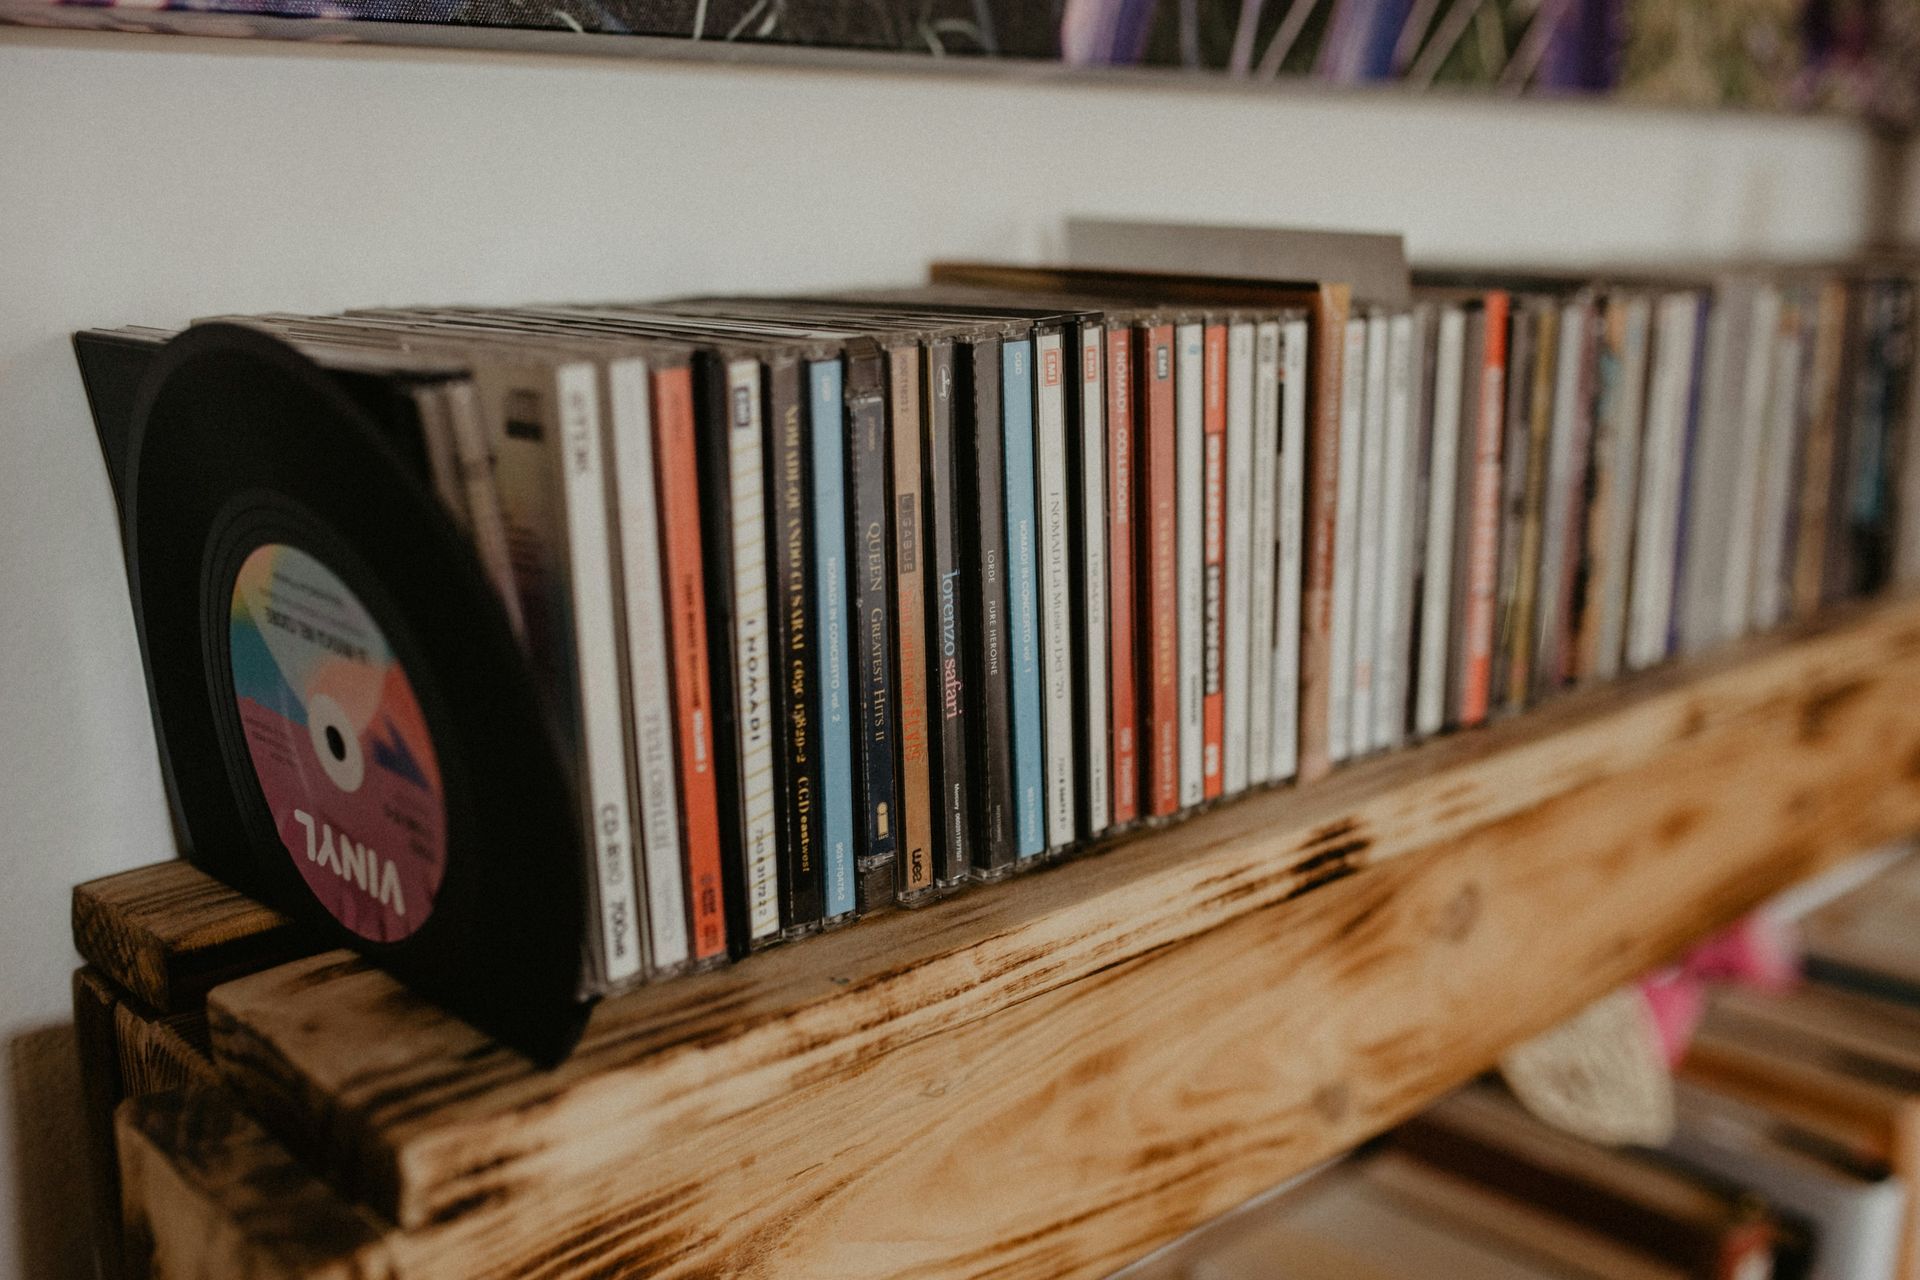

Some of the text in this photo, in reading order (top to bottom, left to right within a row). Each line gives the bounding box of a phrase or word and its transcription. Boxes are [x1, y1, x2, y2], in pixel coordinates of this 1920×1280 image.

[1047, 355, 1057, 380] EMI
[1116, 351, 1127, 414] NOMADI
[1158, 349, 1167, 376] EMI
[1117, 427, 1128, 524] COLLEZIONE
[865, 522, 882, 592] QUEEN
[901, 495, 914, 573] LIGABUE
[1019, 519, 1029, 565] NOMADI
[1051, 499, 1061, 565] NOMADI
[1021, 566, 1030, 579] IN
[829, 607, 838, 621] IN
[987, 549, 998, 676] LORDE PURE HEROINE
[1022, 580, 1031, 643] CONCERTO
[1053, 592, 1063, 644] Musica
[829, 622, 840, 690] CONCERTO
[871, 608, 883, 684] GREATEST
[942, 569, 962, 720] lorenzo safari
[747, 637, 760, 741] NOMADI
[831, 714, 840, 722] 2
[874, 688, 886, 727] HITS
[294, 808, 406, 917] VINYL
[912, 847, 922, 884] wea
